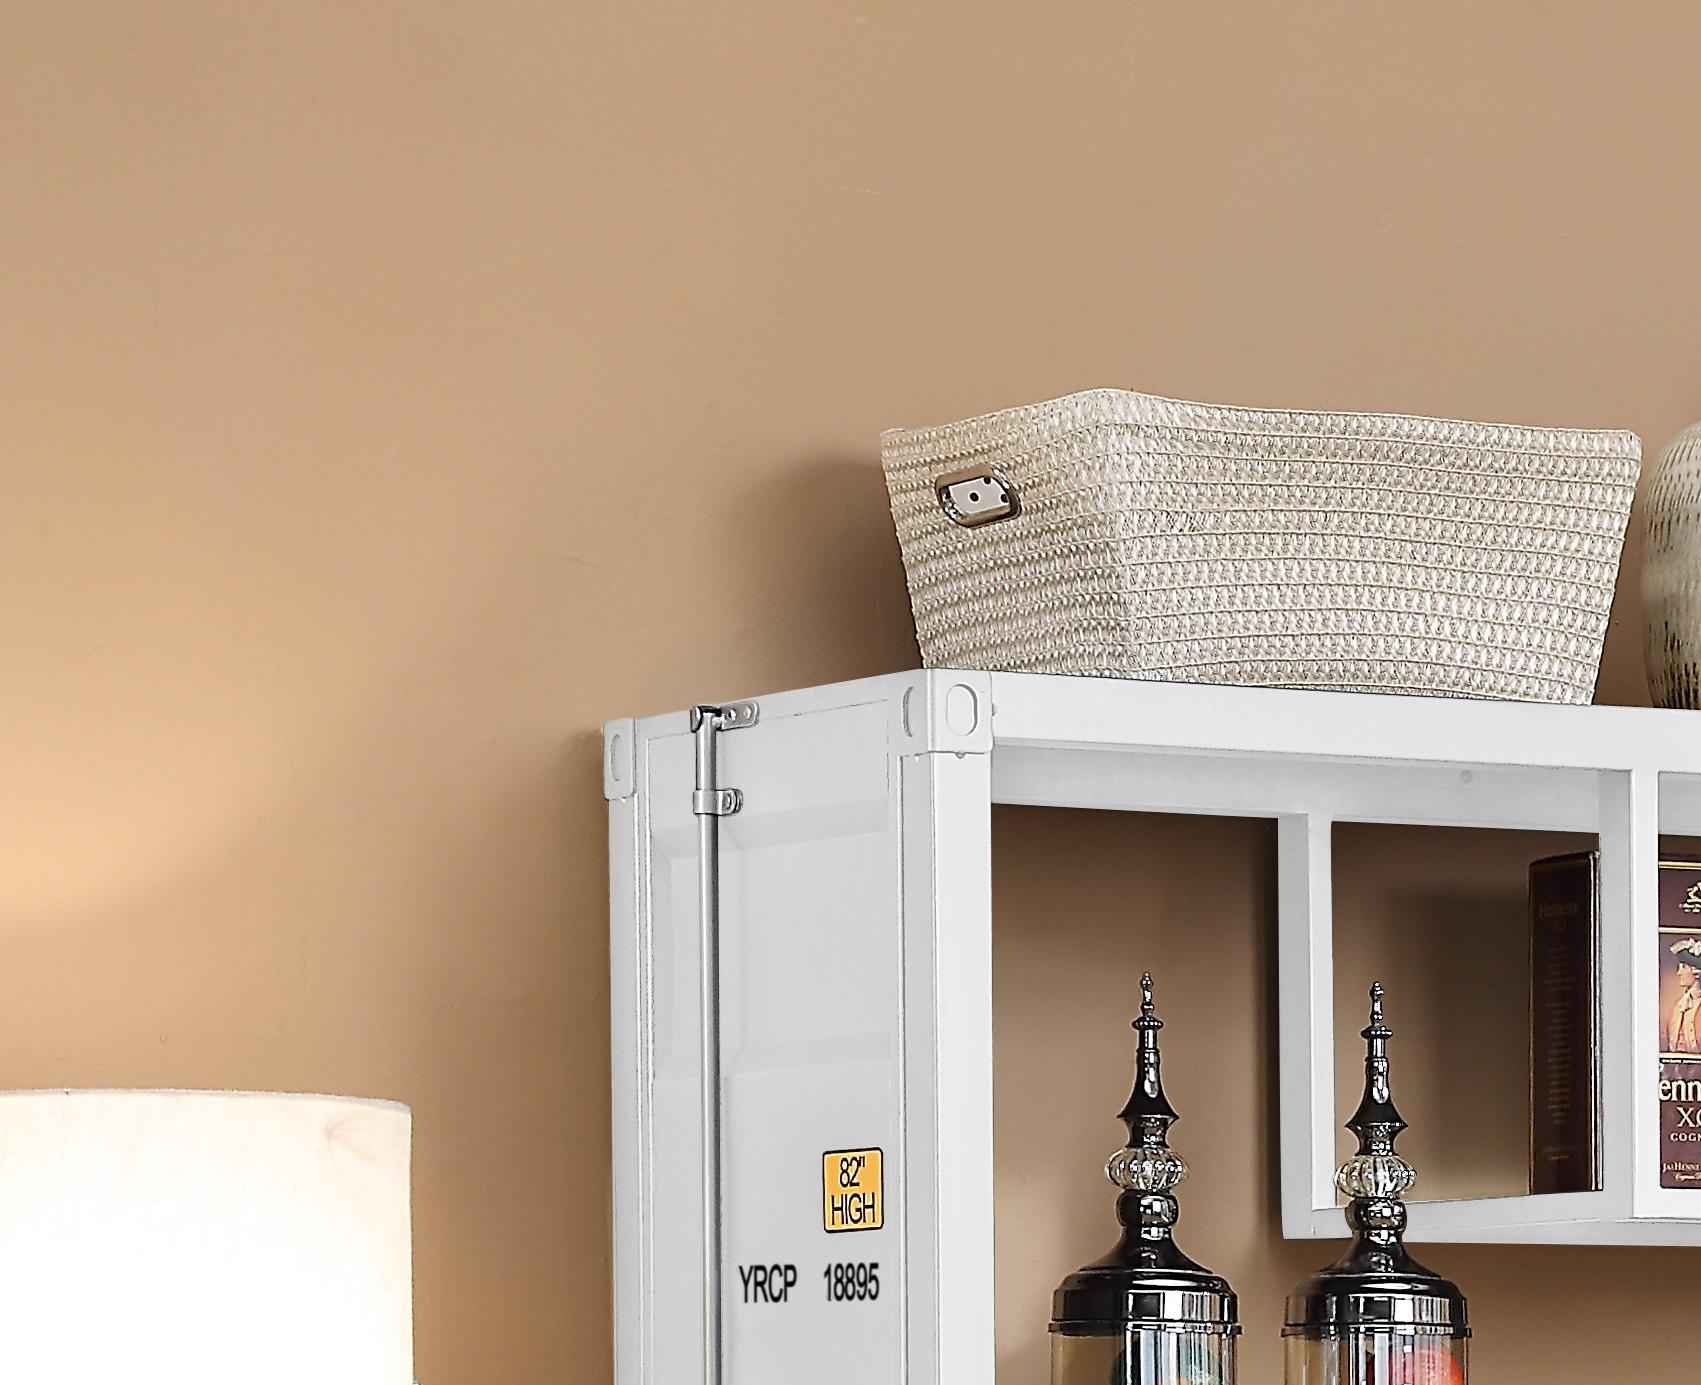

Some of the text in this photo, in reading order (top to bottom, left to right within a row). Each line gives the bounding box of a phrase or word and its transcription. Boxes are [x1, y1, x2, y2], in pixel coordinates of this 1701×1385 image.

[840, 1155, 865, 1188] 82"
[831, 1191, 876, 1226] HIGH
[738, 1262, 880, 1304] YRCP 18895
